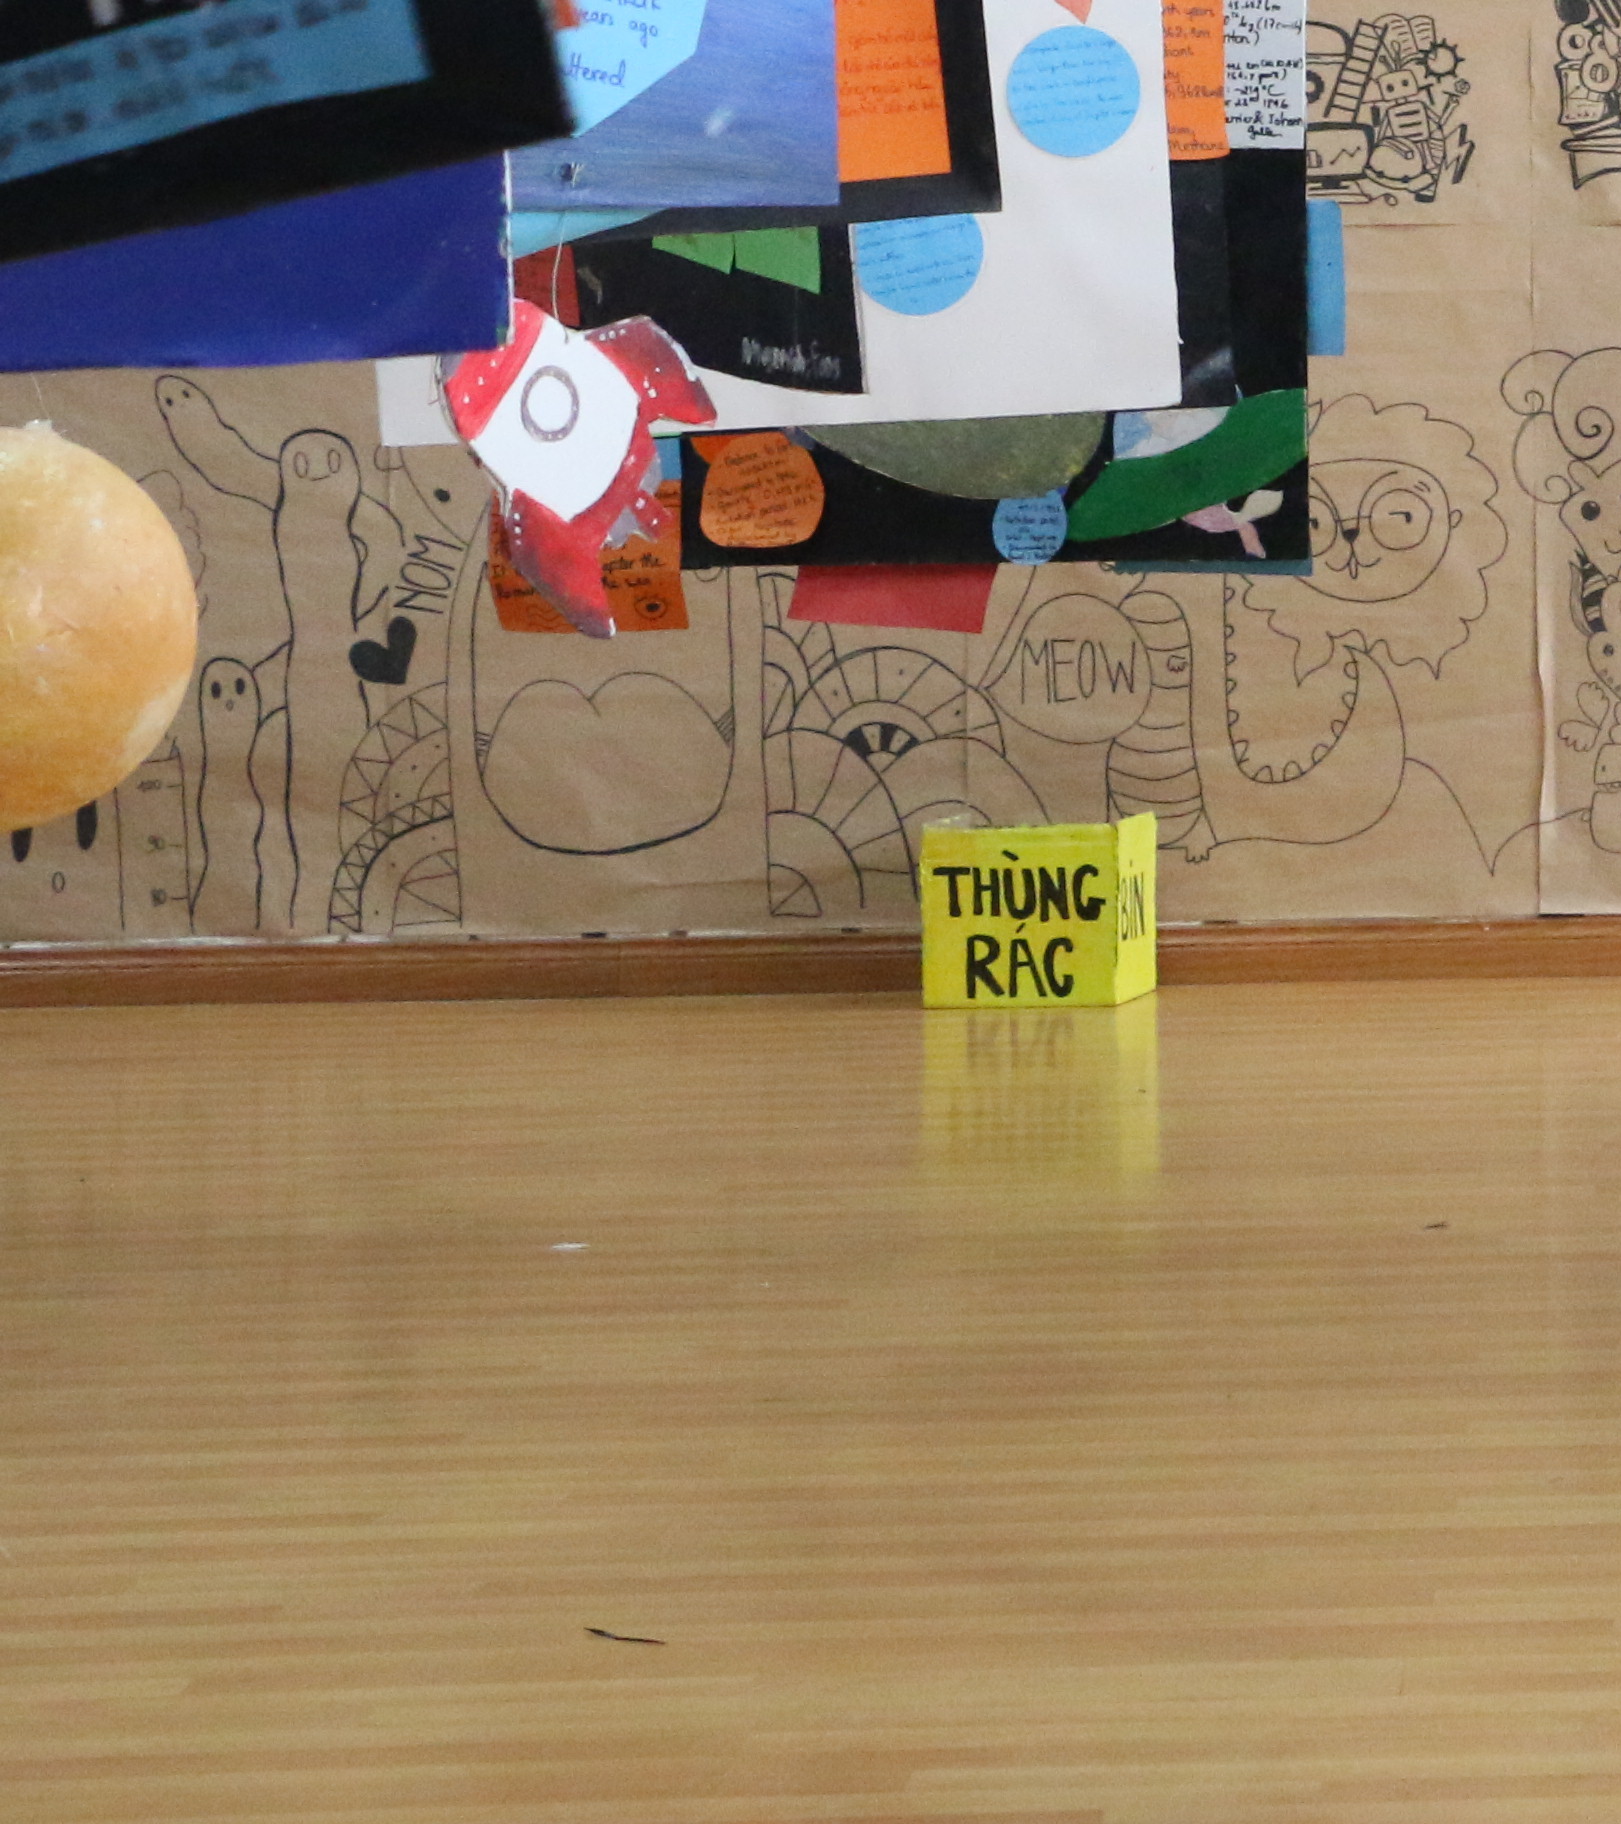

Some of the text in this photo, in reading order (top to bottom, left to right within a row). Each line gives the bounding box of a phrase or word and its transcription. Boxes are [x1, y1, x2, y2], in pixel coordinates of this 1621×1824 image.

[1020, 637, 1136, 705] MEOW
[932, 849, 1106, 923] THÙNG
[964, 925, 1074, 999] RÁC
